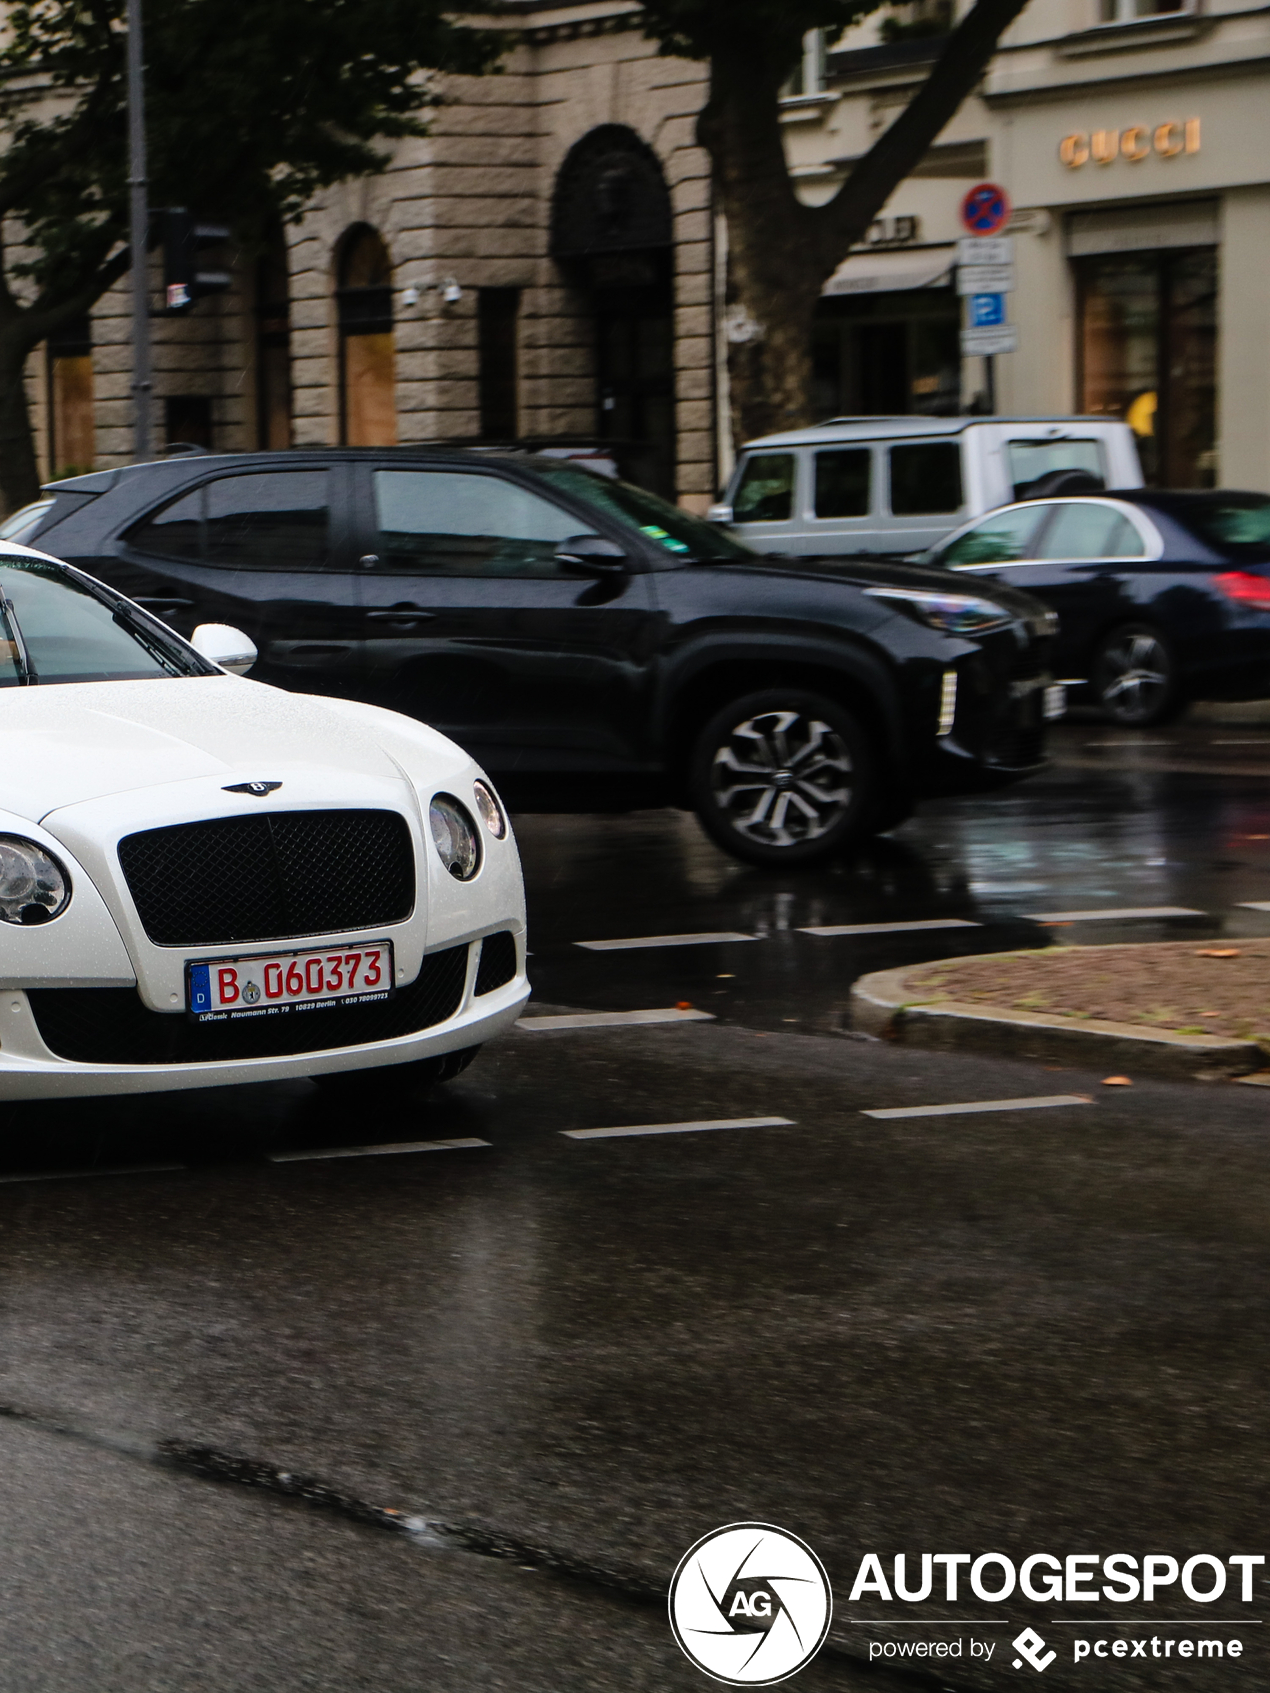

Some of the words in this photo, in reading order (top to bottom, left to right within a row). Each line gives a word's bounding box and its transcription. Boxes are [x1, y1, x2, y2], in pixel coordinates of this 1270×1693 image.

[1060, 117, 1201, 168] GUCCI
[218, 968, 240, 1004] B
[264, 950, 382, 999] 060373
[197, 993, 205, 1003] D
[231, 1008, 267, 1019] Naumann
[316, 1001, 336, 1009] Berlin
